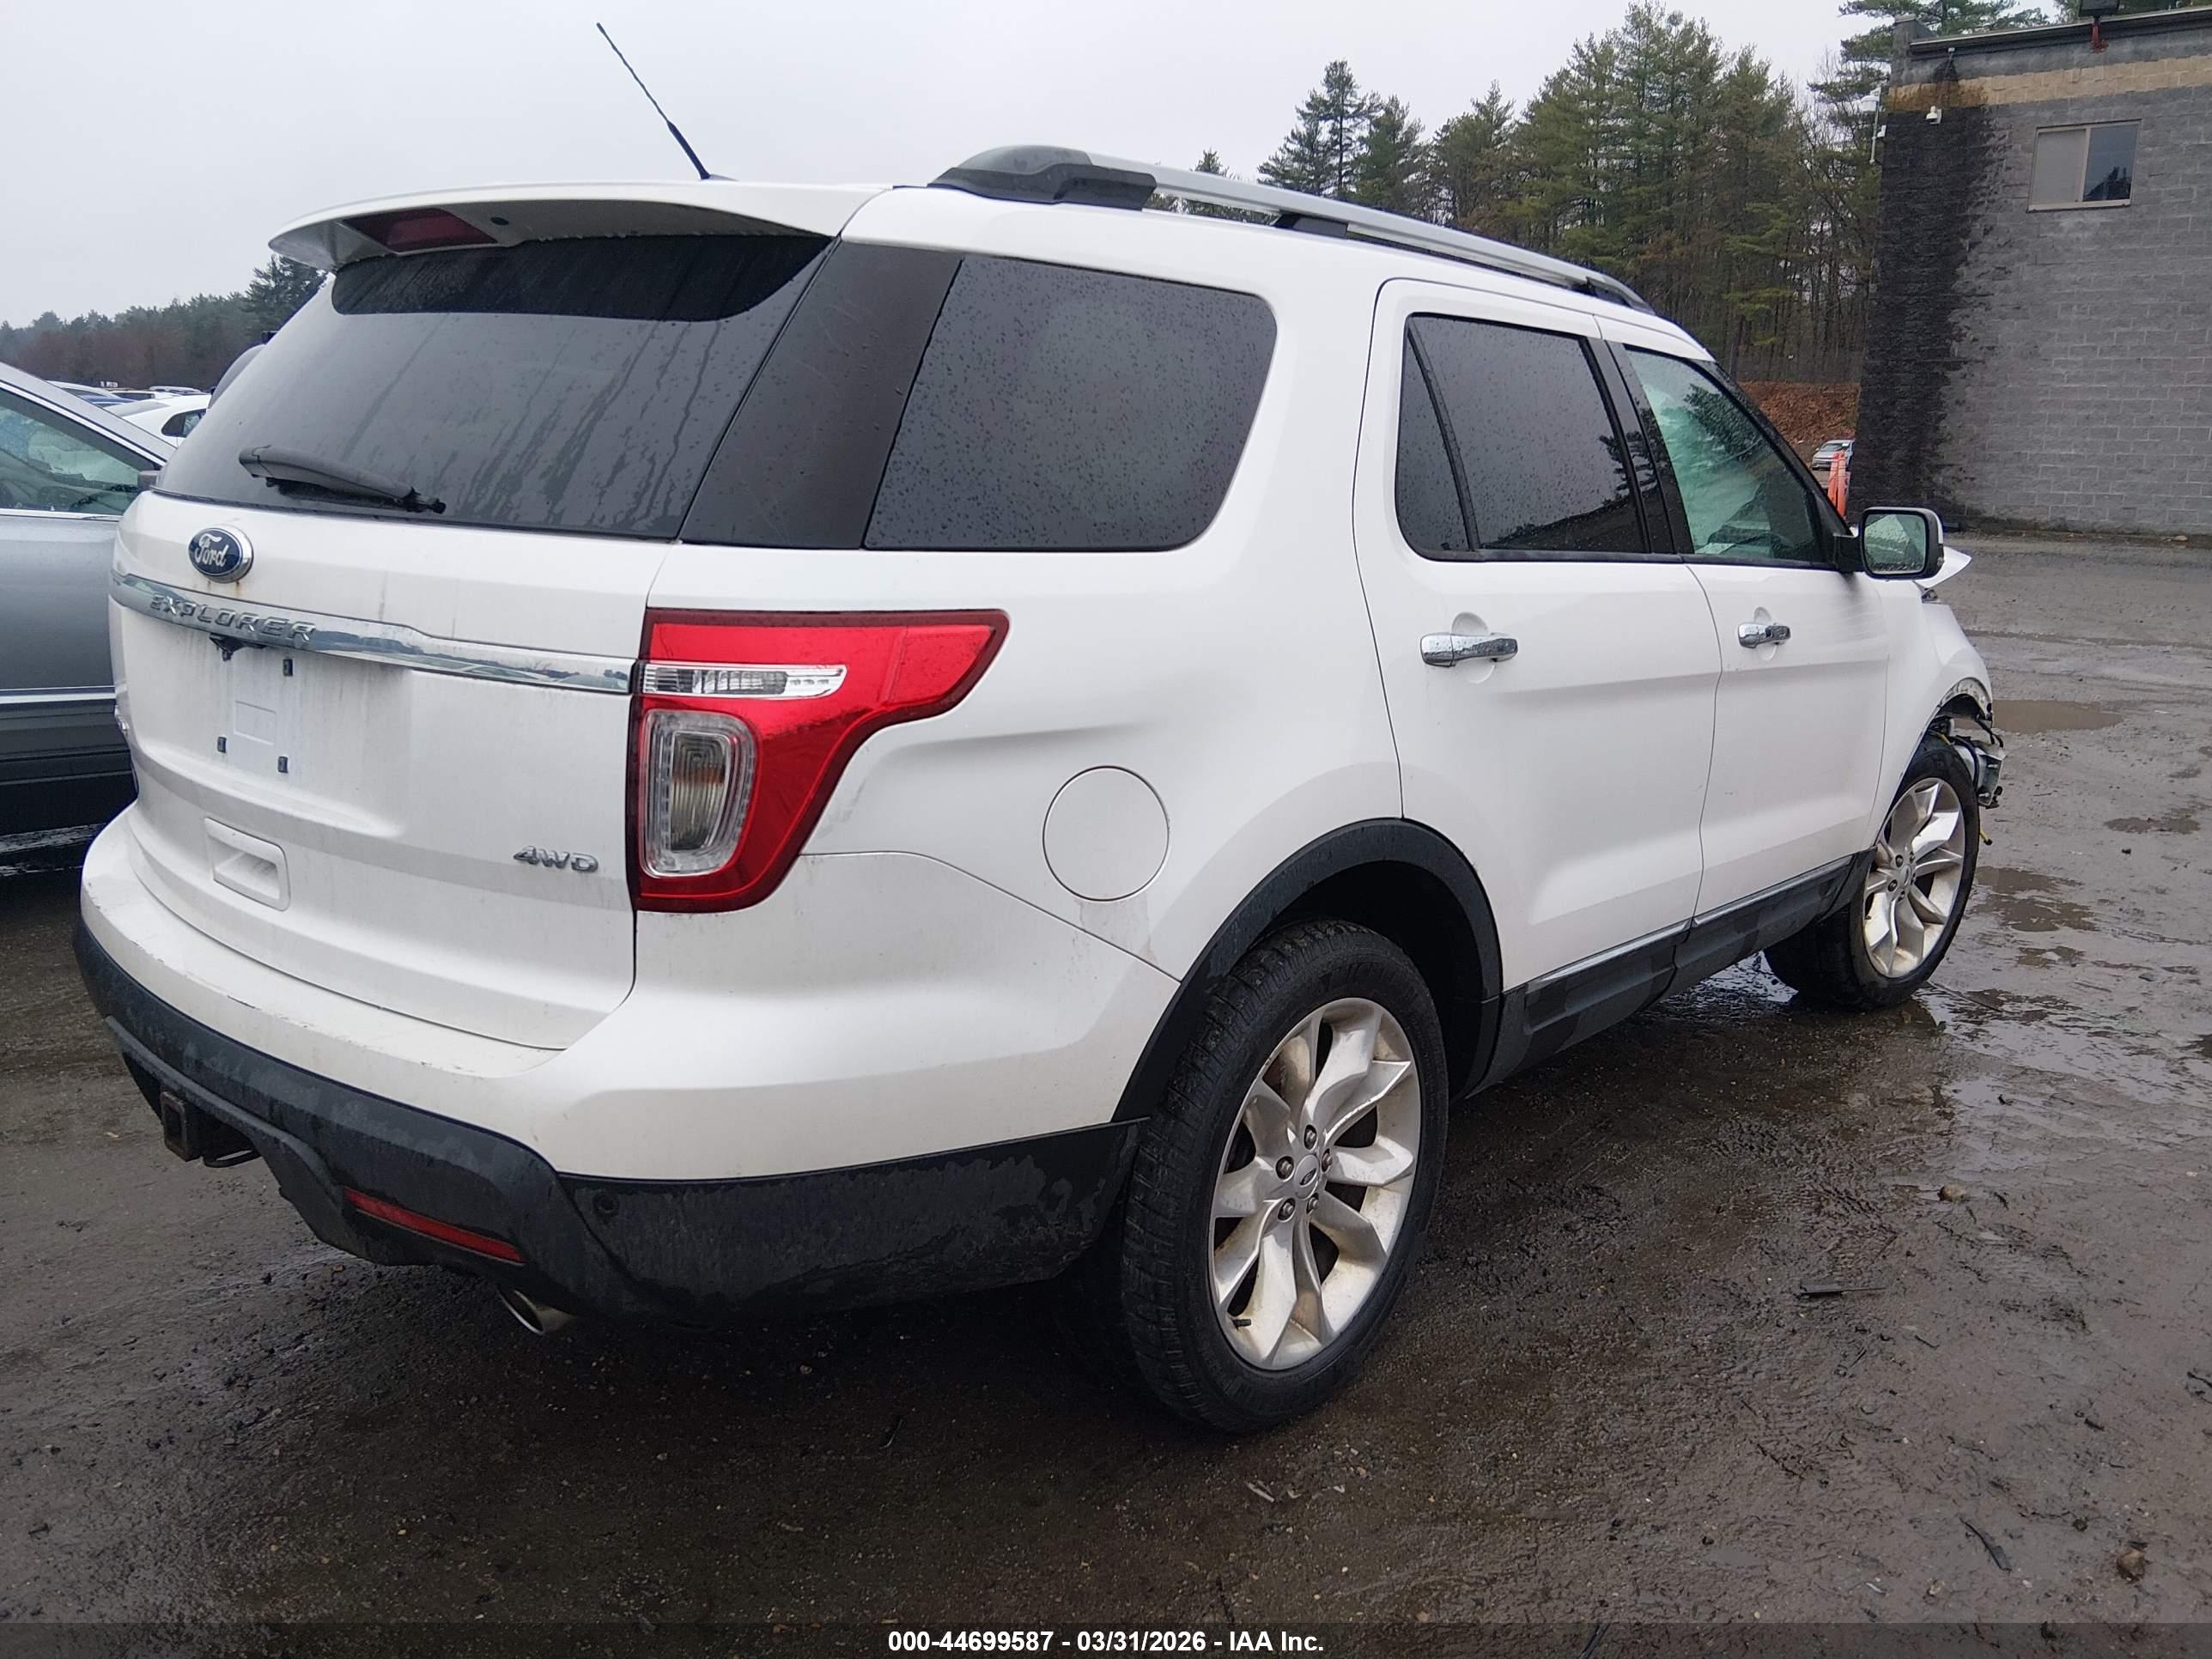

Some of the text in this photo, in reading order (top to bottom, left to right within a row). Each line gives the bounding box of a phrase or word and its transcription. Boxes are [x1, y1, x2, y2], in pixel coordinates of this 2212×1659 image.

[194, 532, 230, 568] Ford
[149, 593, 317, 641] EXPLORER
[513, 845, 599, 873] 4WD
